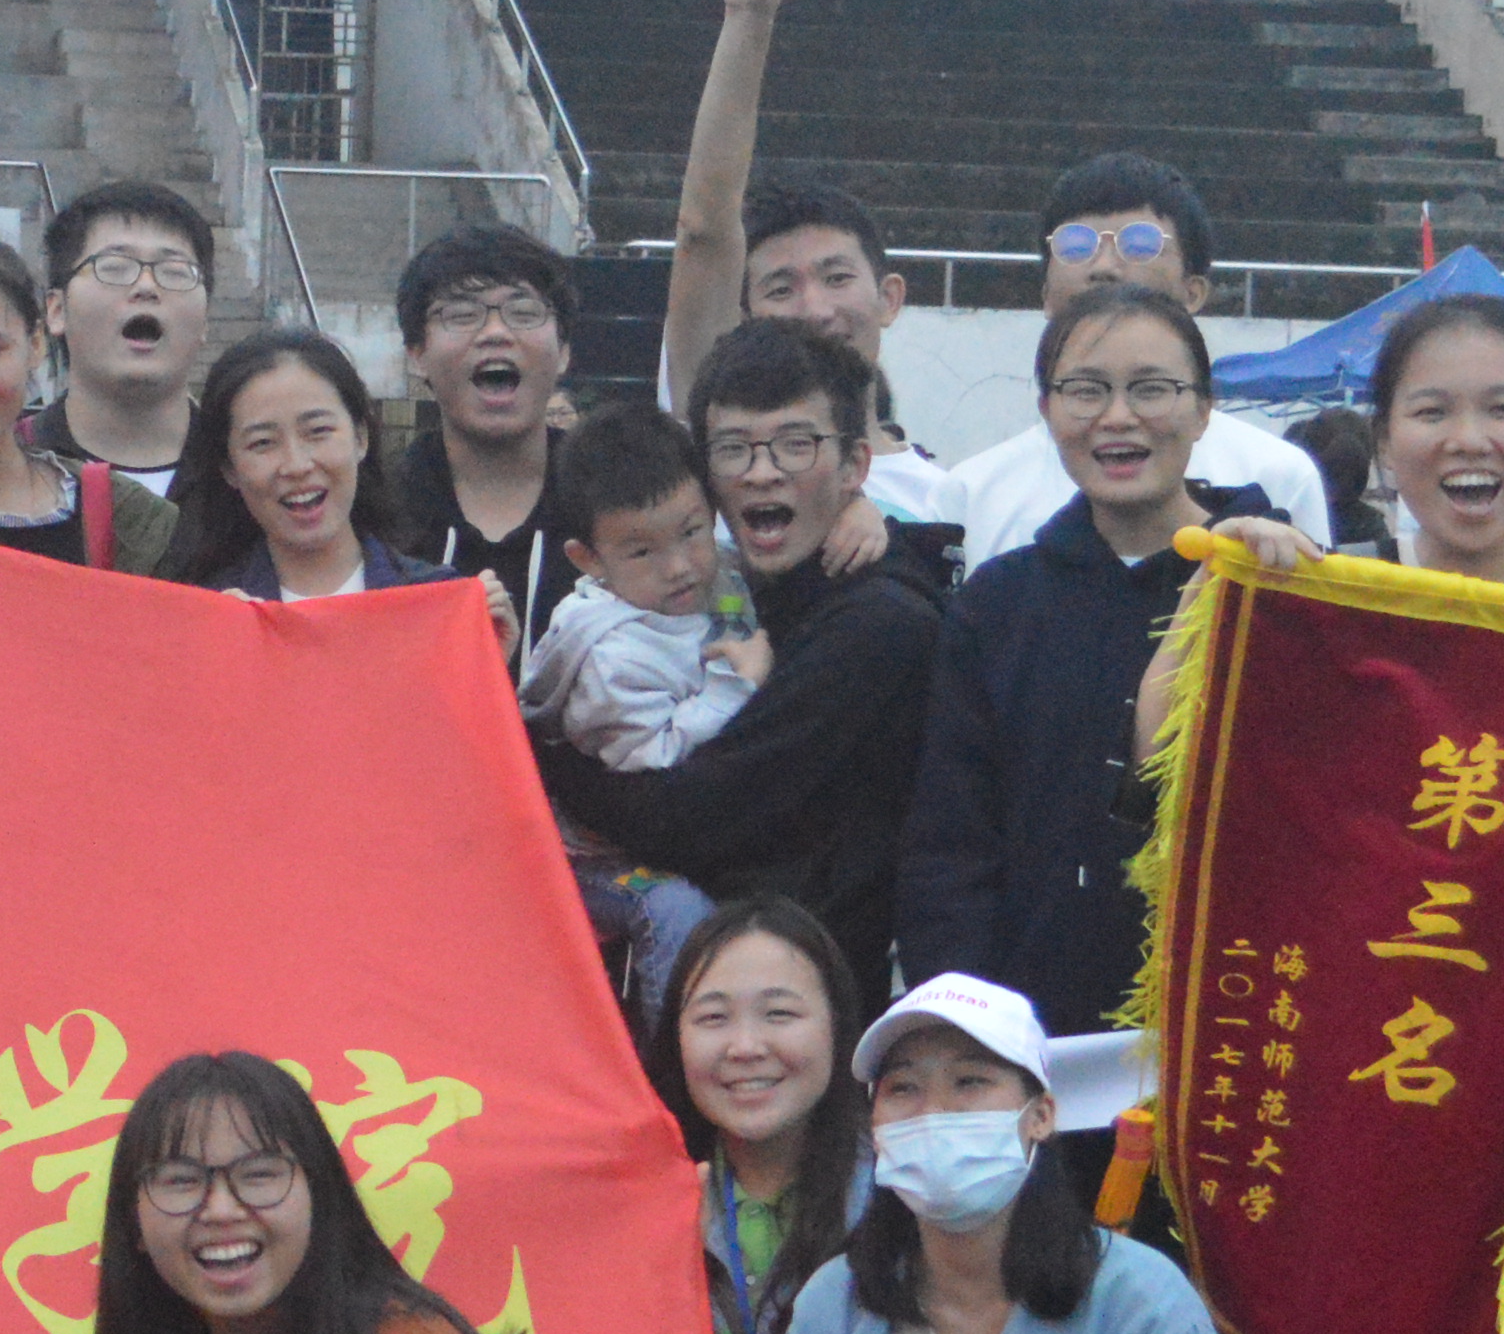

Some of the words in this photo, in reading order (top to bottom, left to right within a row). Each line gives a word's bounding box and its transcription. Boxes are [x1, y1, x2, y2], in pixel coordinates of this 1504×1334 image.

[1239, 944, 1307, 1222] 海南师范大学
